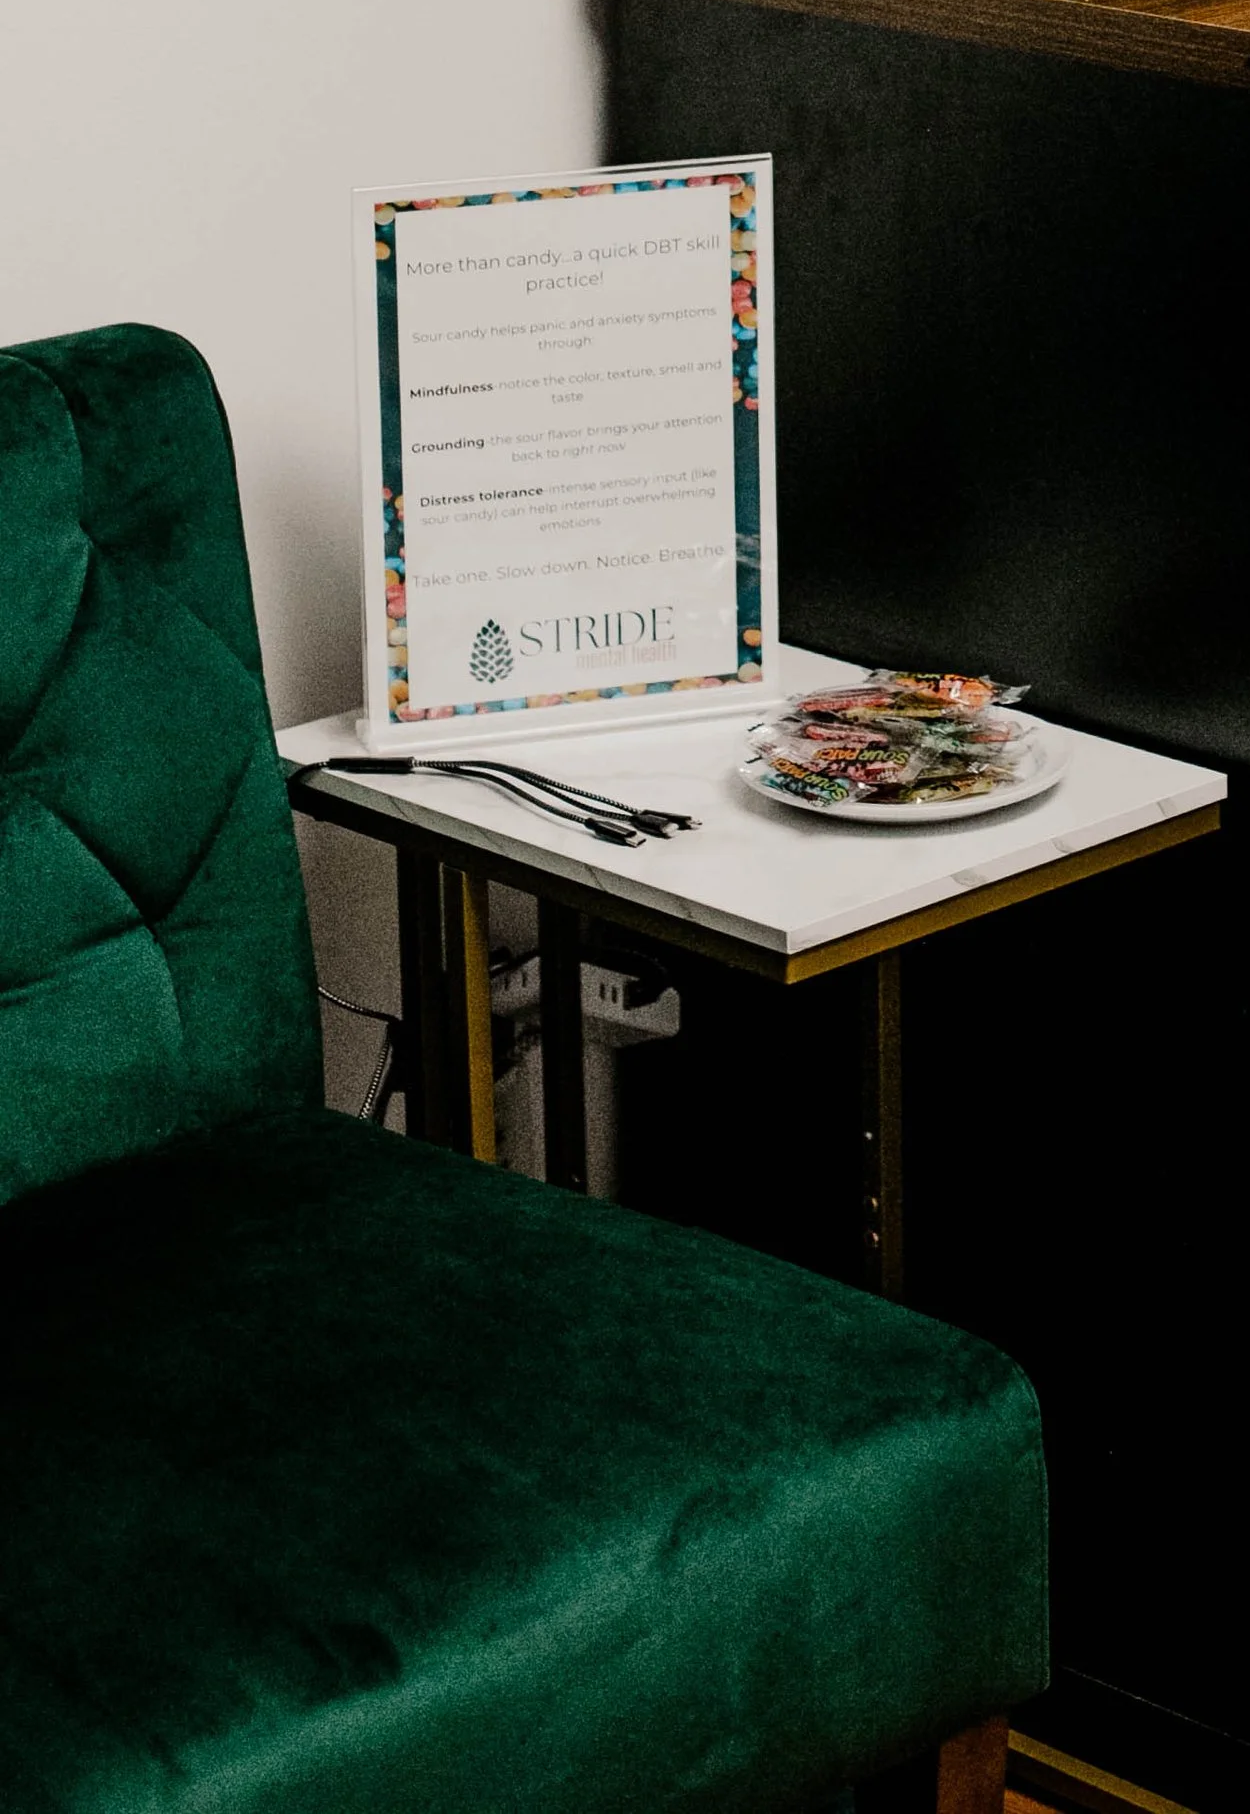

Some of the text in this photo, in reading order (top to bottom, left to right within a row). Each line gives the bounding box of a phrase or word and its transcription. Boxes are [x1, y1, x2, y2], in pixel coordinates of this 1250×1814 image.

[406, 261, 453, 276] More
[458, 256, 500, 272] than
[588, 243, 638, 263] quick
[644, 237, 682, 256] DBT
[686, 235, 720, 252] skill
[525, 270, 604, 294] practice!
[411, 306, 717, 344] Sour candy helps panic and anxiety symptoms
[543, 372, 566, 386] the
[659, 361, 694, 375] smell
[696, 359, 723, 372] and
[551, 391, 584, 405] taste
[515, 434, 544, 444] sour
[547, 428, 583, 441] flavor
[586, 424, 629, 438] brings
[631, 420, 661, 434] your
[663, 413, 723, 430] attention
[511, 442, 627, 463] back to right now
[420, 494, 475, 508] Distress
[600, 475, 650, 490] sensory
[421, 515, 451, 526] sour
[501, 506, 526, 519] can
[528, 501, 558, 515] help
[561, 496, 619, 511] interrupt
[622, 486, 716, 505] overwhelming
[412, 573, 451, 589] Take
[496, 565, 537, 581] Slow
[519, 605, 675, 657] STRIDE
[632, 641, 677, 664] health
